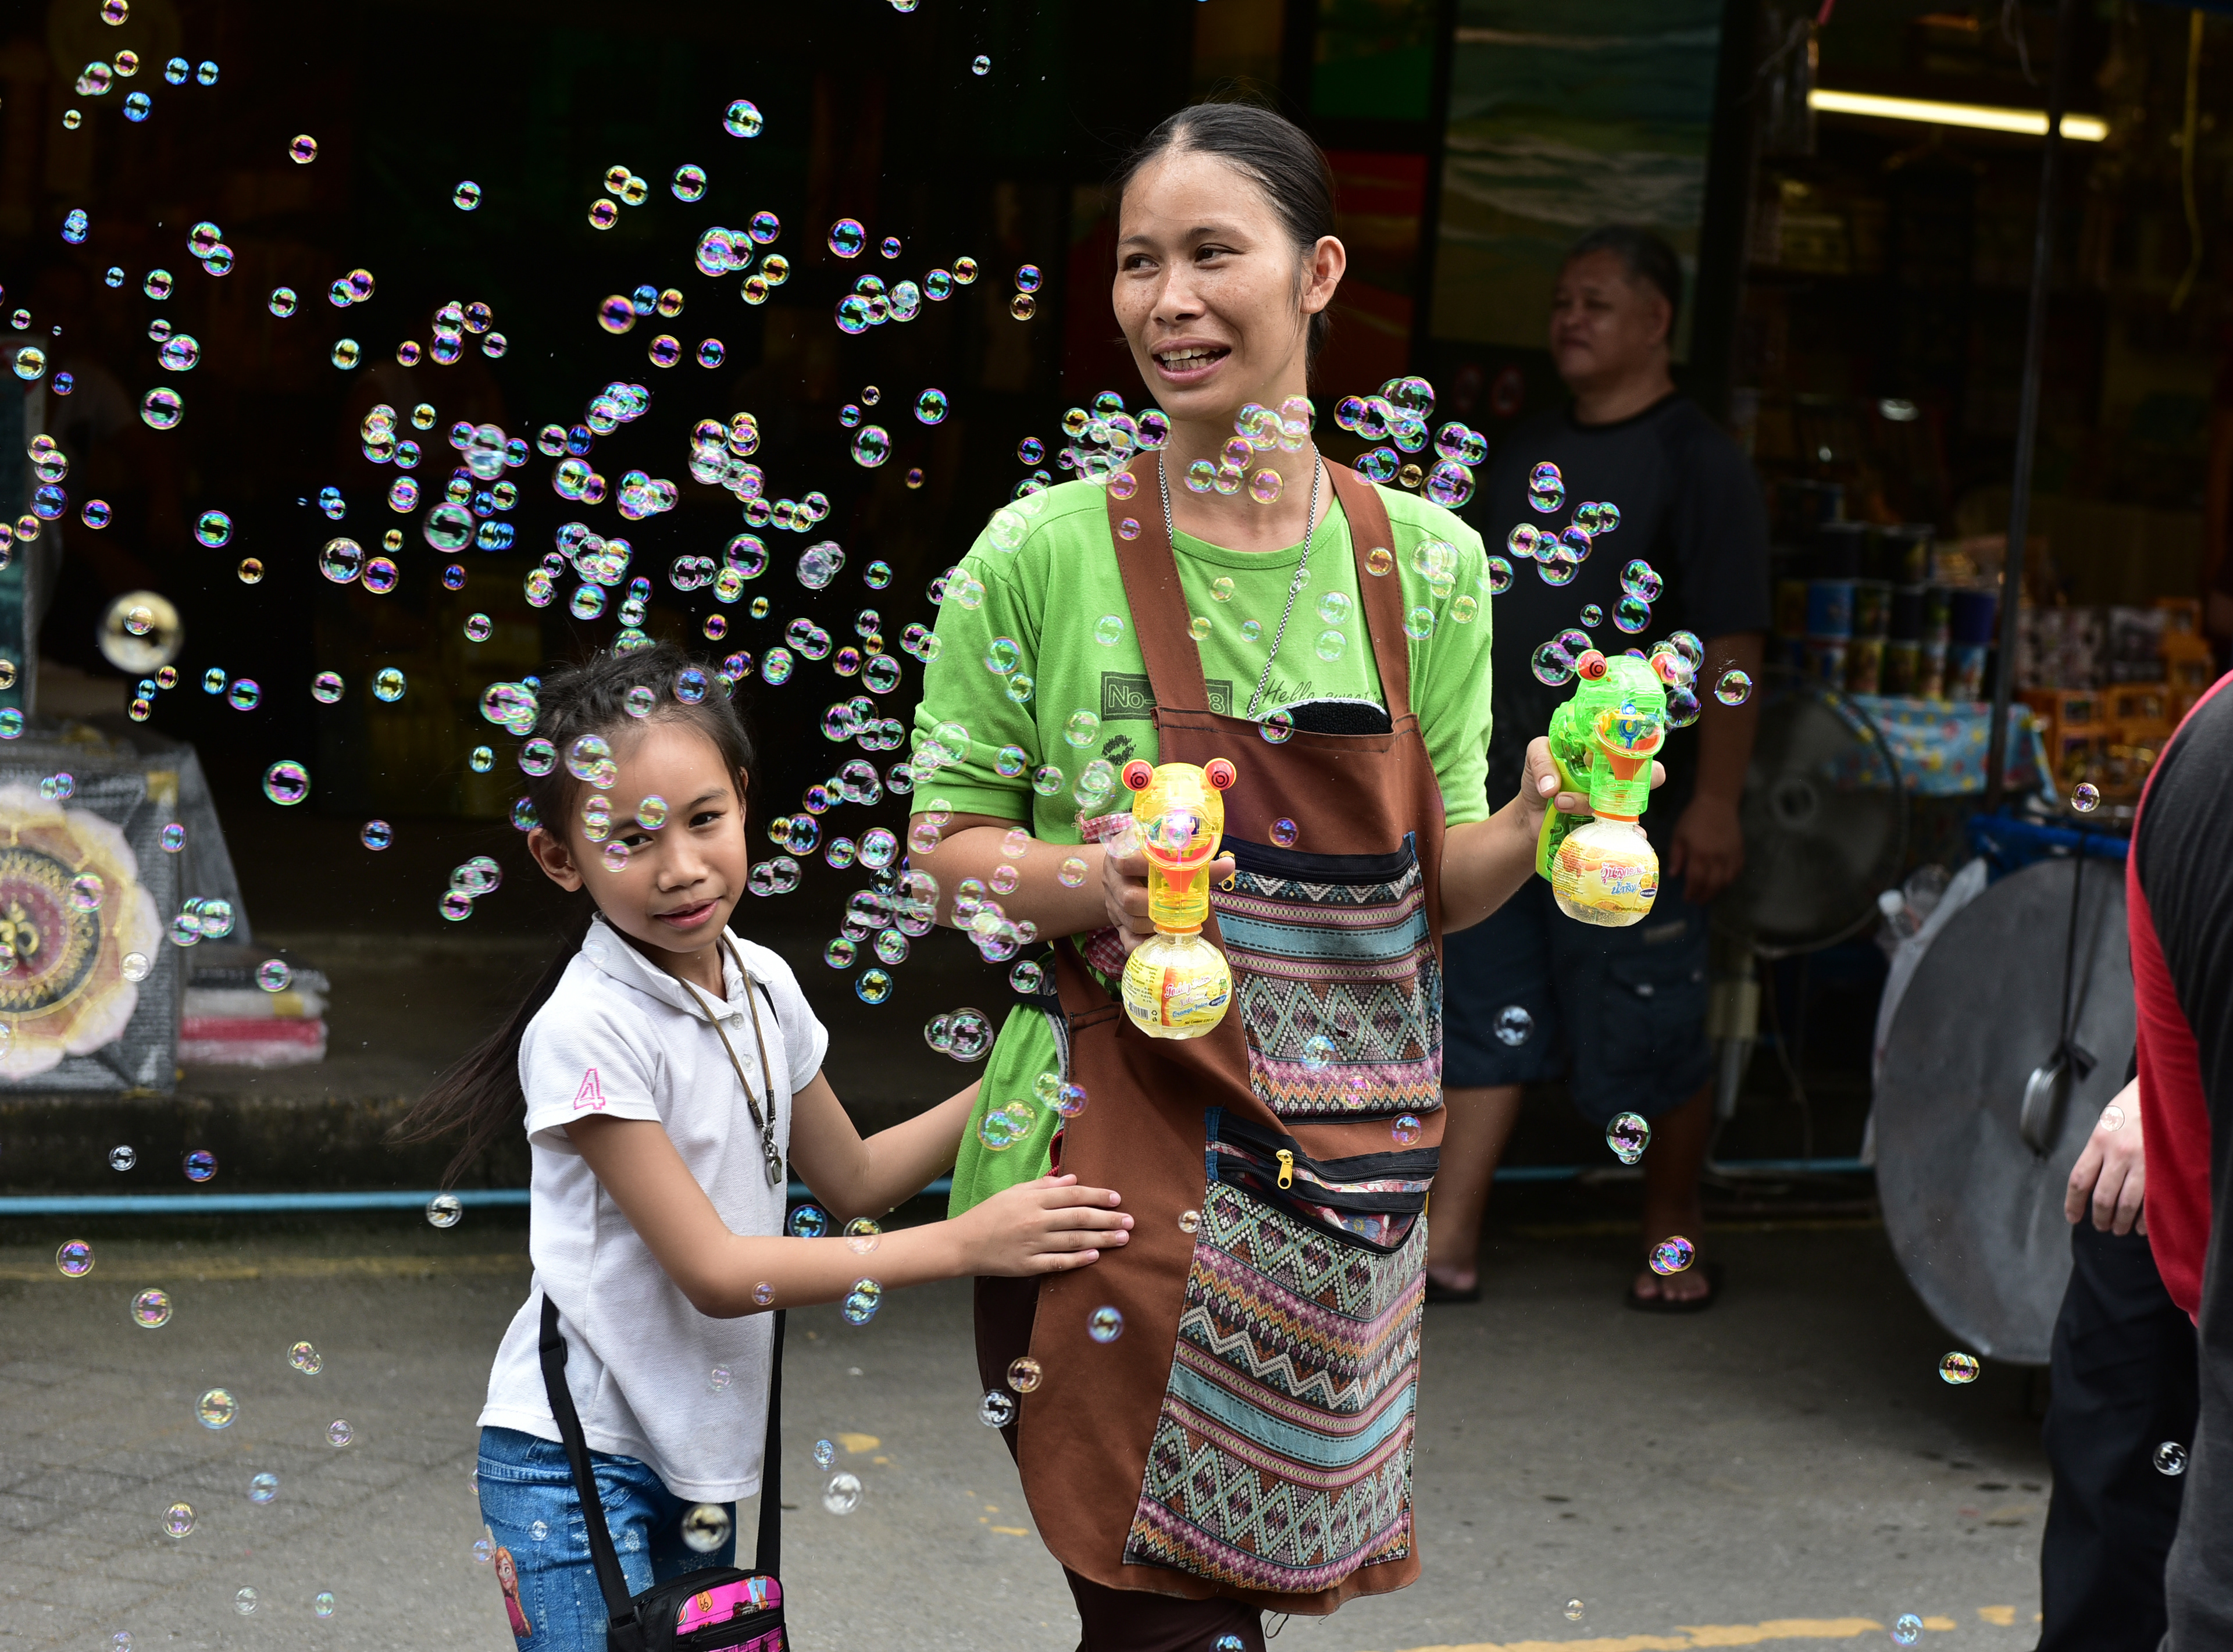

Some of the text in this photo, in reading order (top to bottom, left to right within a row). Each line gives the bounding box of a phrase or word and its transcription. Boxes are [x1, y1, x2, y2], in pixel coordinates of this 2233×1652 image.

[1262, 679, 1315, 704] Hello
[1611, 881, 1637, 894] น้ำส้ม
[1172, 1002, 1208, 1018] Orange Juice
[573, 1068, 606, 1111] 4
[700, 1597, 709, 1610] 66
